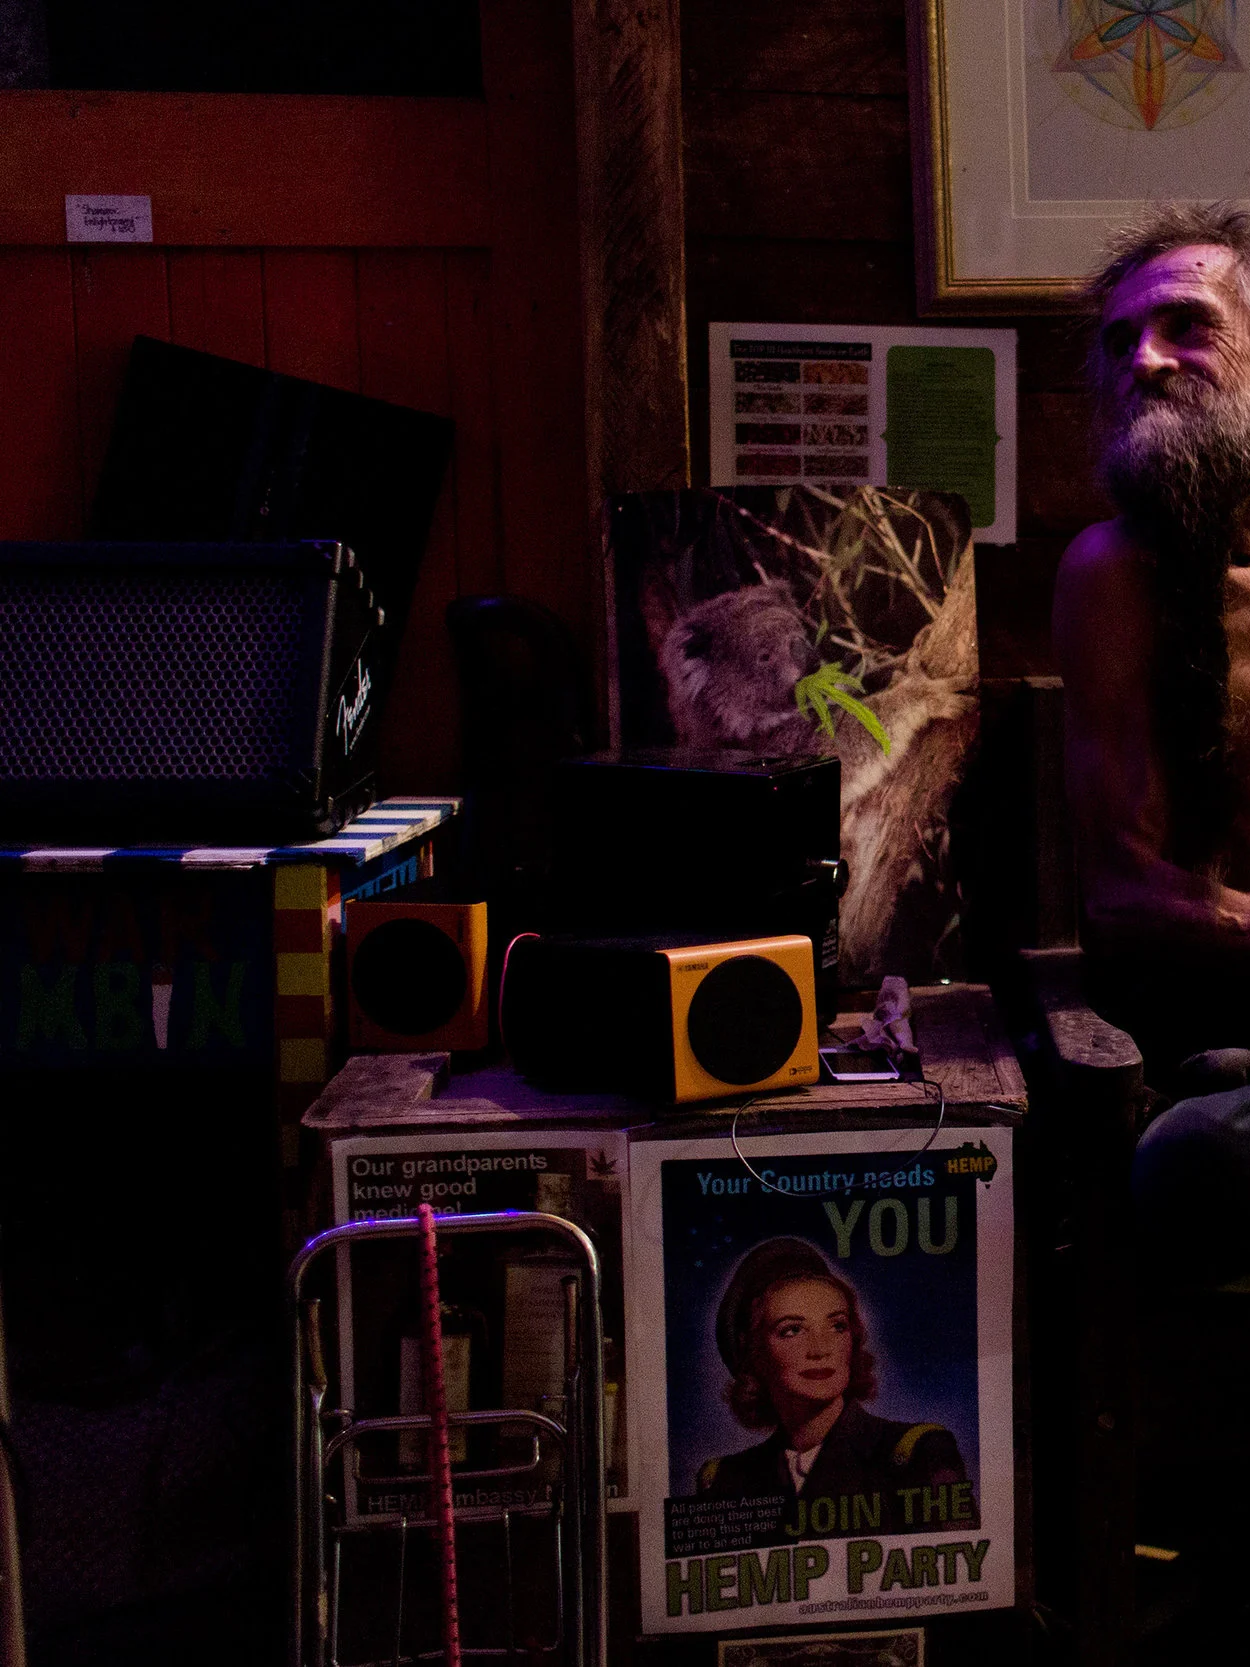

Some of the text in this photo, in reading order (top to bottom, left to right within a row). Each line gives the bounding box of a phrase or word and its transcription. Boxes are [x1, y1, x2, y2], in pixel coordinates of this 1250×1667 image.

[351, 1152, 548, 1180] Our grandparents
[696, 1155, 995, 1196] Your Country needs HEMP
[353, 1176, 477, 1201] knew good
[354, 1200, 461, 1220] medicne!
[822, 1195, 959, 1259] YOU
[367, 1493, 429, 1515] HEM
[455, 1488, 536, 1508] mbassy
[670, 1495, 786, 1515] All patriotic Aussies
[784, 1480, 973, 1537] JOIN THE
[671, 1506, 784, 1527] are doing their best
[671, 1519, 778, 1540] to bring this tragic
[672, 1535, 753, 1553] war to an end
[665, 1538, 990, 1617] HEMP PARTY
[798, 1591, 989, 1614] australianhempparty.com
